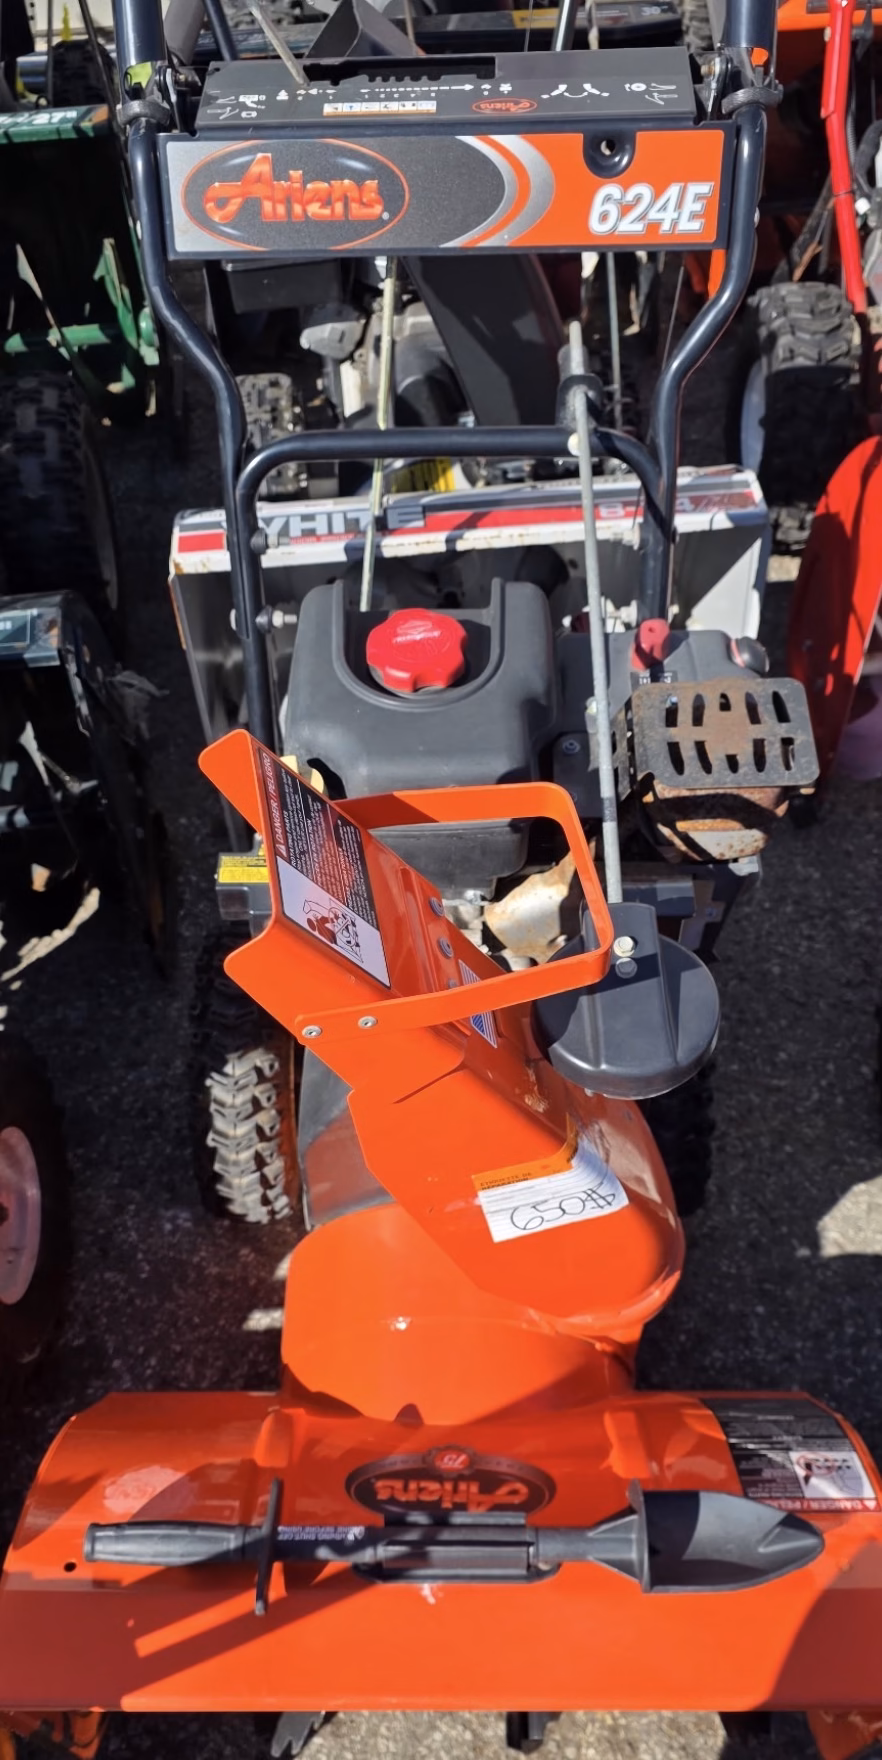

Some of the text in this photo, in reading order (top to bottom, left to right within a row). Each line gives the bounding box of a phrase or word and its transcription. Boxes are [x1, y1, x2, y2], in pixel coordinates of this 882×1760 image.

[203, 153, 384, 223] Ariens
[588, 182, 715, 236] 624E
[262, 752, 277, 796] PELIGRO
[270, 800, 284, 841] DANGER
[287, 832, 297, 868] ROTATING
[374, 1480, 529, 1513] Ariens
